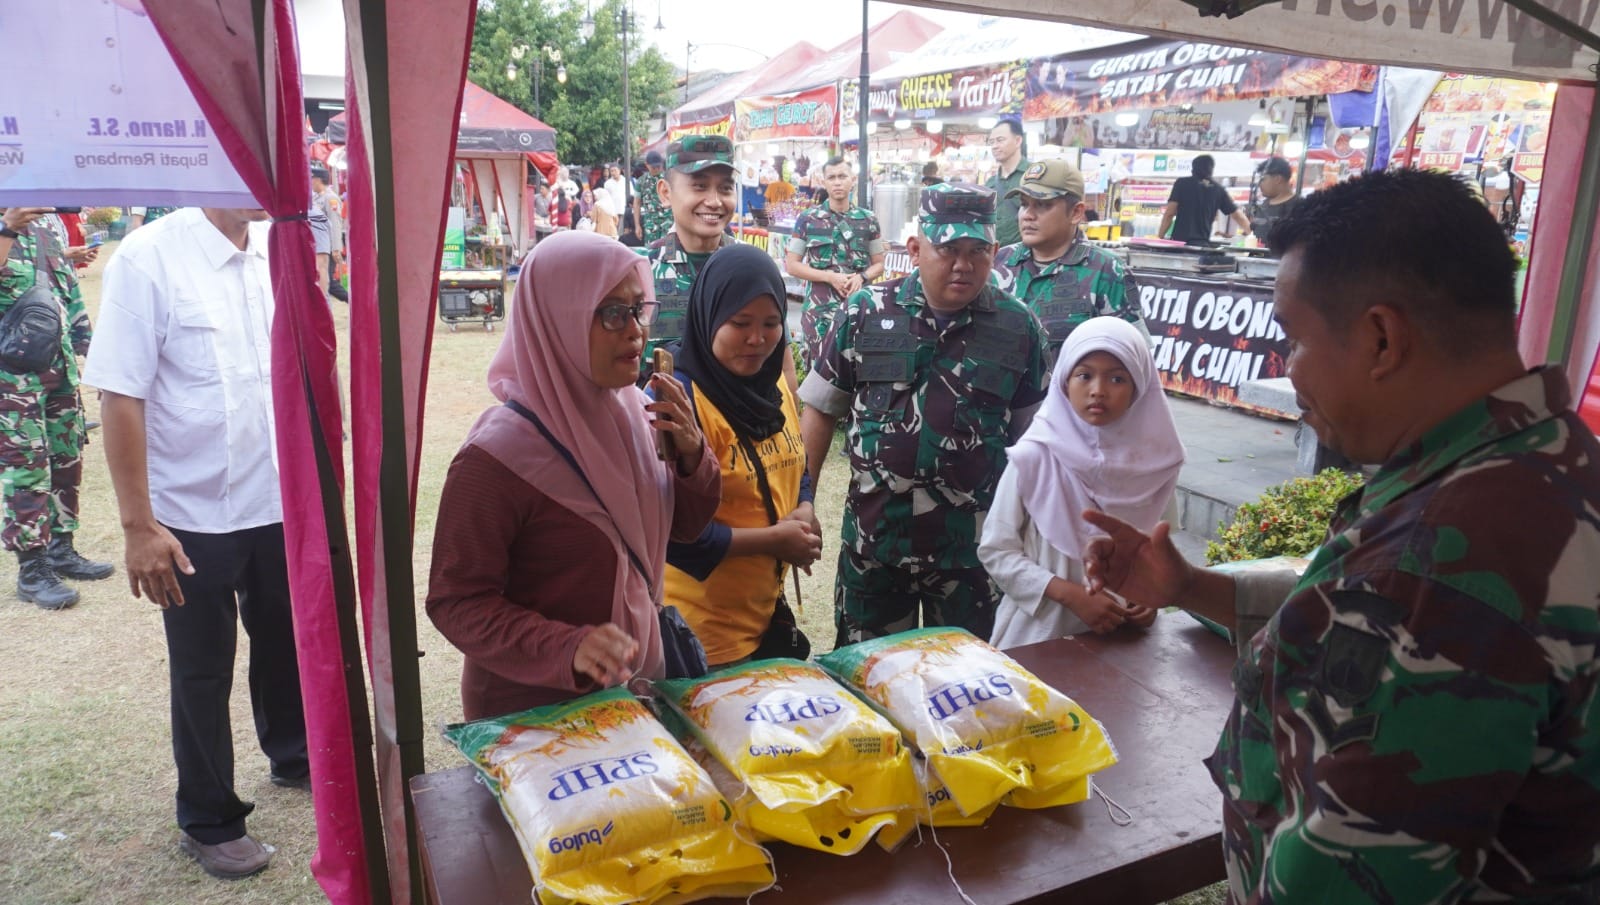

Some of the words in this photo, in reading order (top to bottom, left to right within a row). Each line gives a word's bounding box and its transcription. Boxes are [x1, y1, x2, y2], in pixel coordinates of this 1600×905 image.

[1088, 48, 1168, 78] GURITA
[1100, 73, 1174, 100] SATAY
[1175, 63, 1247, 89] CUMI
[900, 73, 952, 111] CHEESE
[1138, 285, 1191, 325] RITA
[861, 336, 909, 348] EZRA
[1150, 335, 1193, 373] TAY
[1191, 343, 1265, 387] CUMI
[744, 695, 841, 724] SPHP
[928, 675, 1014, 721] SPHP
[547, 753, 659, 801] SPHP
[926, 786, 951, 807] log
[548, 827, 602, 854] bulog
